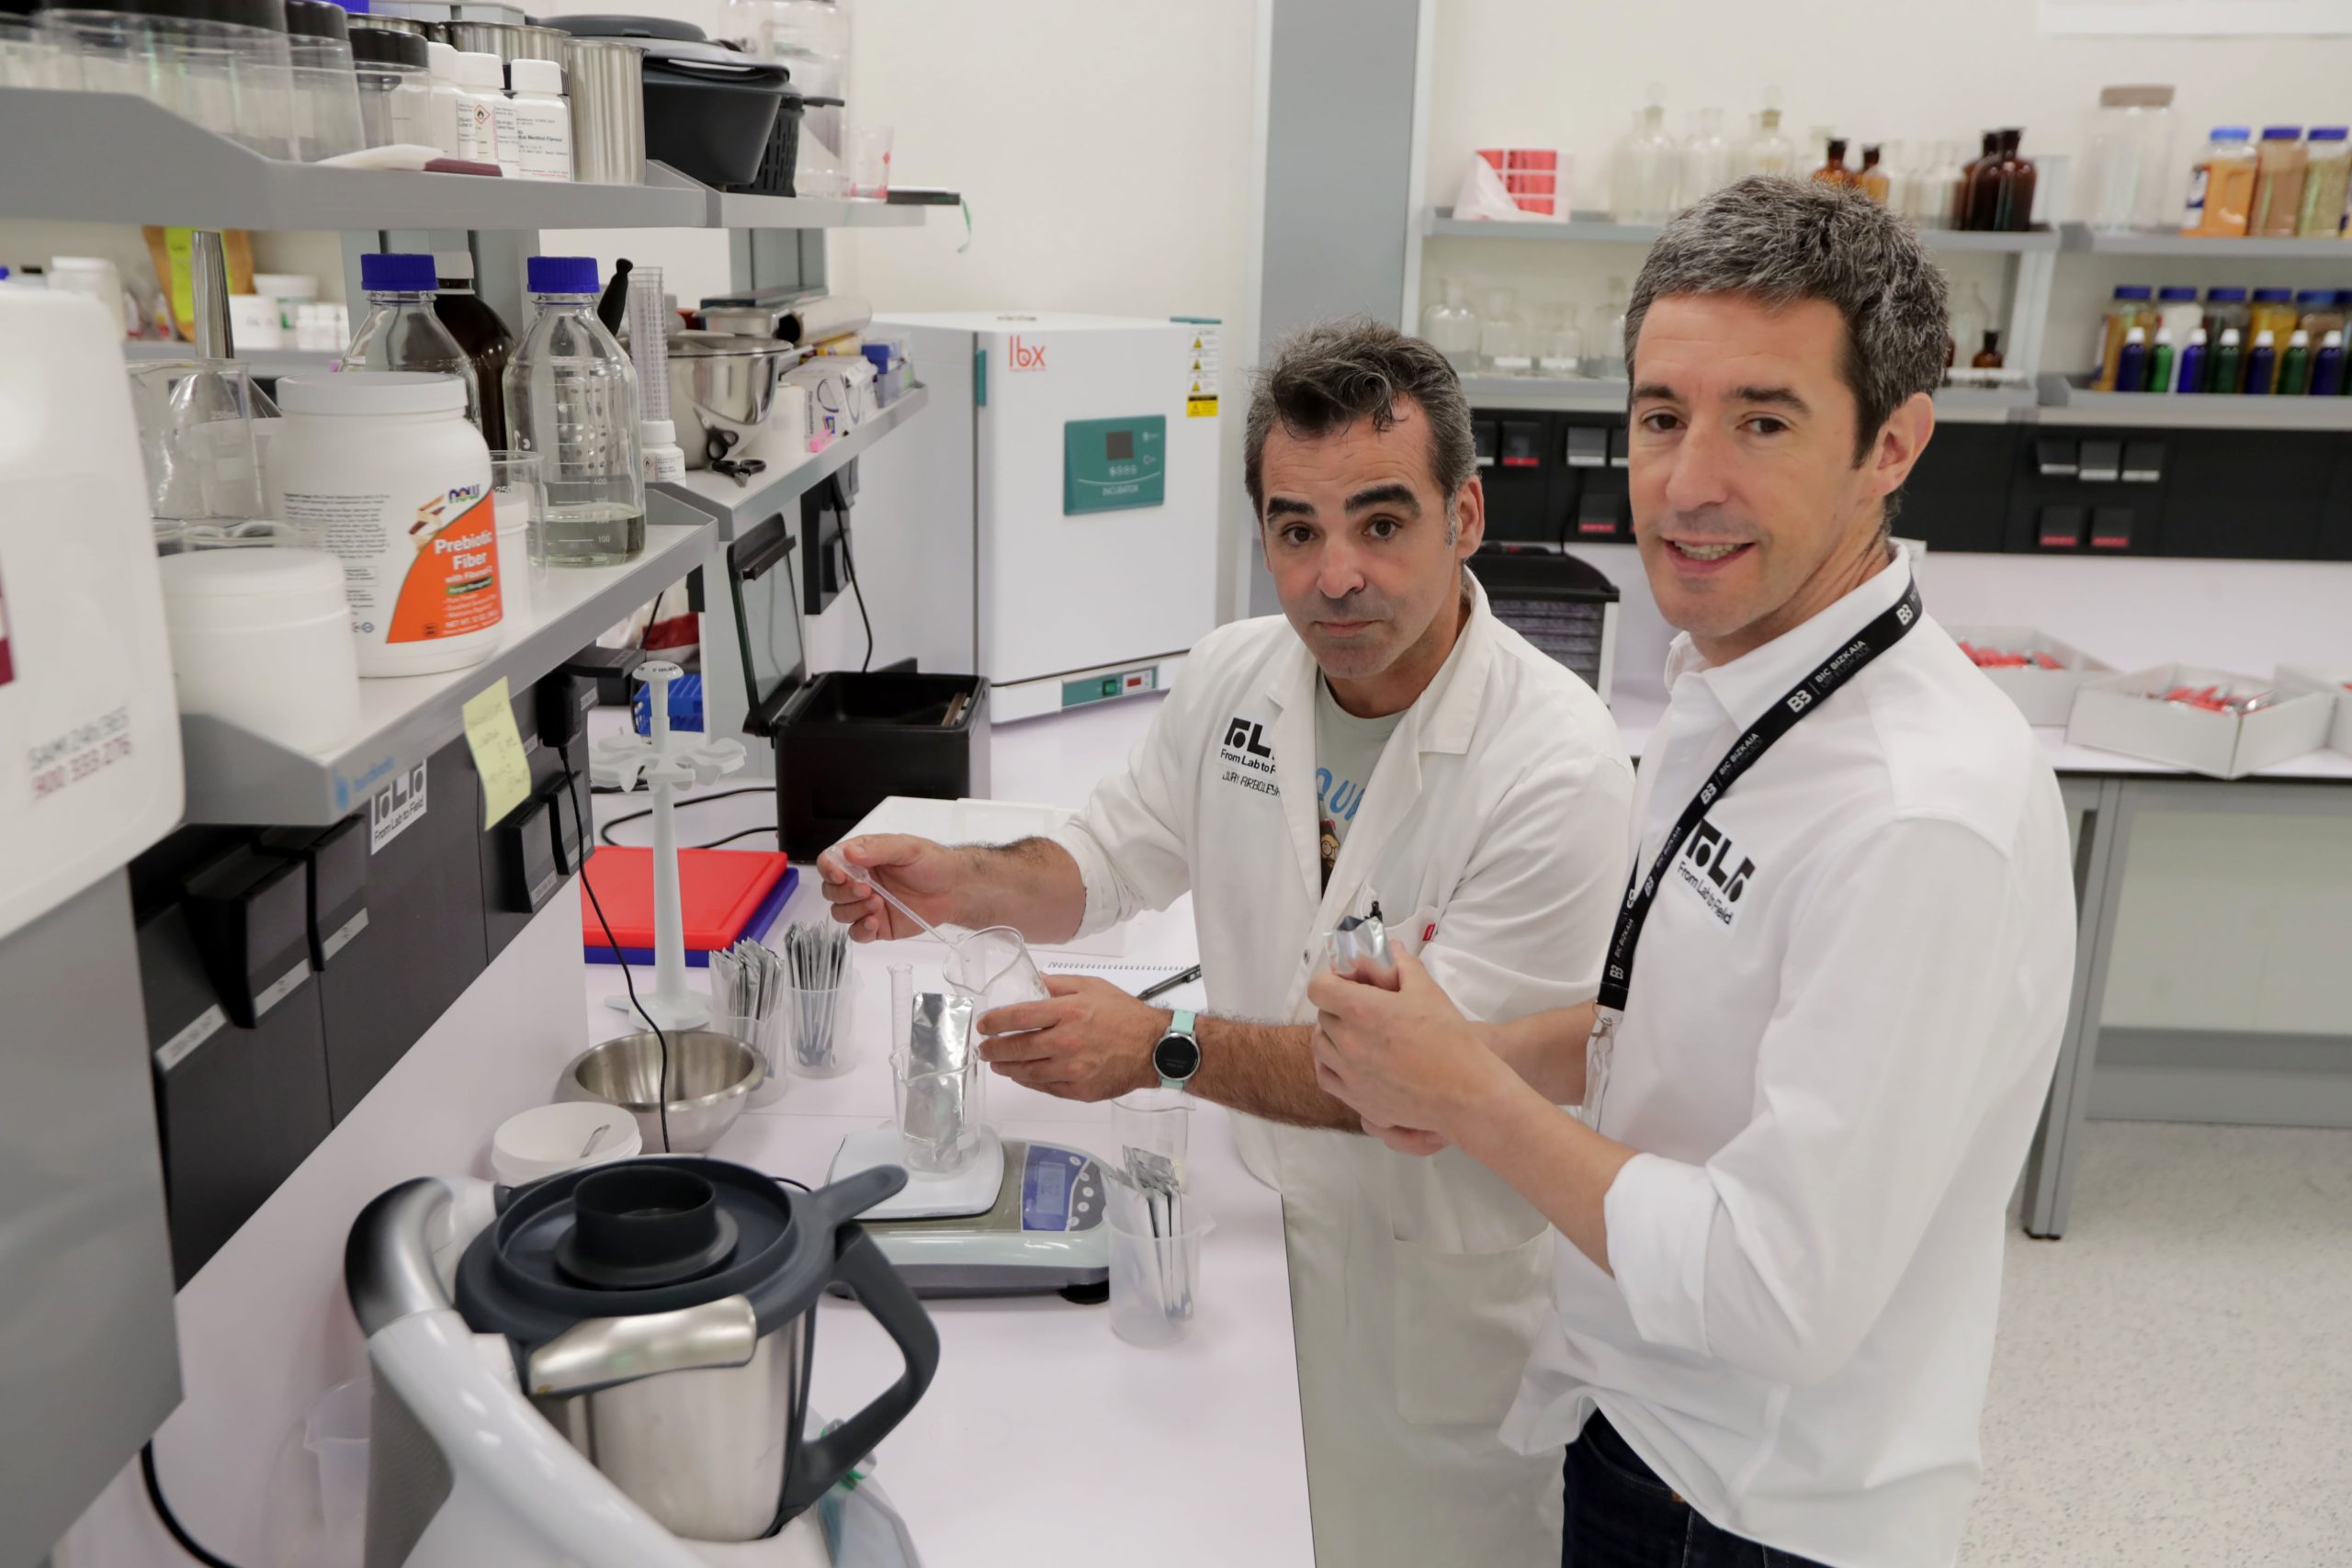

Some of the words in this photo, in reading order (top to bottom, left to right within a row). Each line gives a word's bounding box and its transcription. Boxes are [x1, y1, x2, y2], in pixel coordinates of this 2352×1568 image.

[1102, 484, 1139, 496] INCUBATOR
[434, 529, 492, 555] Prebiotic
[452, 552, 488, 570] Fiber
[1815, 668, 1831, 682] BIC
[1830, 640, 1866, 670] BIZKAIA
[1786, 689, 1813, 713] B3
[1220, 748, 1240, 763] From
[1241, 754, 1261, 770] Lab
[1261, 761, 1270, 773] to
[1719, 761, 1731, 775] BIC
[1729, 733, 1759, 762] BIZKAIA
[1700, 783, 1717, 805] B3
[374, 823, 391, 843] From
[391, 814, 403, 829] Lab
[403, 808, 412, 820] to
[410, 794, 424, 813] Field
[1678, 861, 1699, 888] From
[1697, 879, 1711, 900] Lab
[1713, 898, 1735, 925] Field
[1618, 918, 1634, 947] BIZKAIA
[1610, 964, 1624, 980] B3
